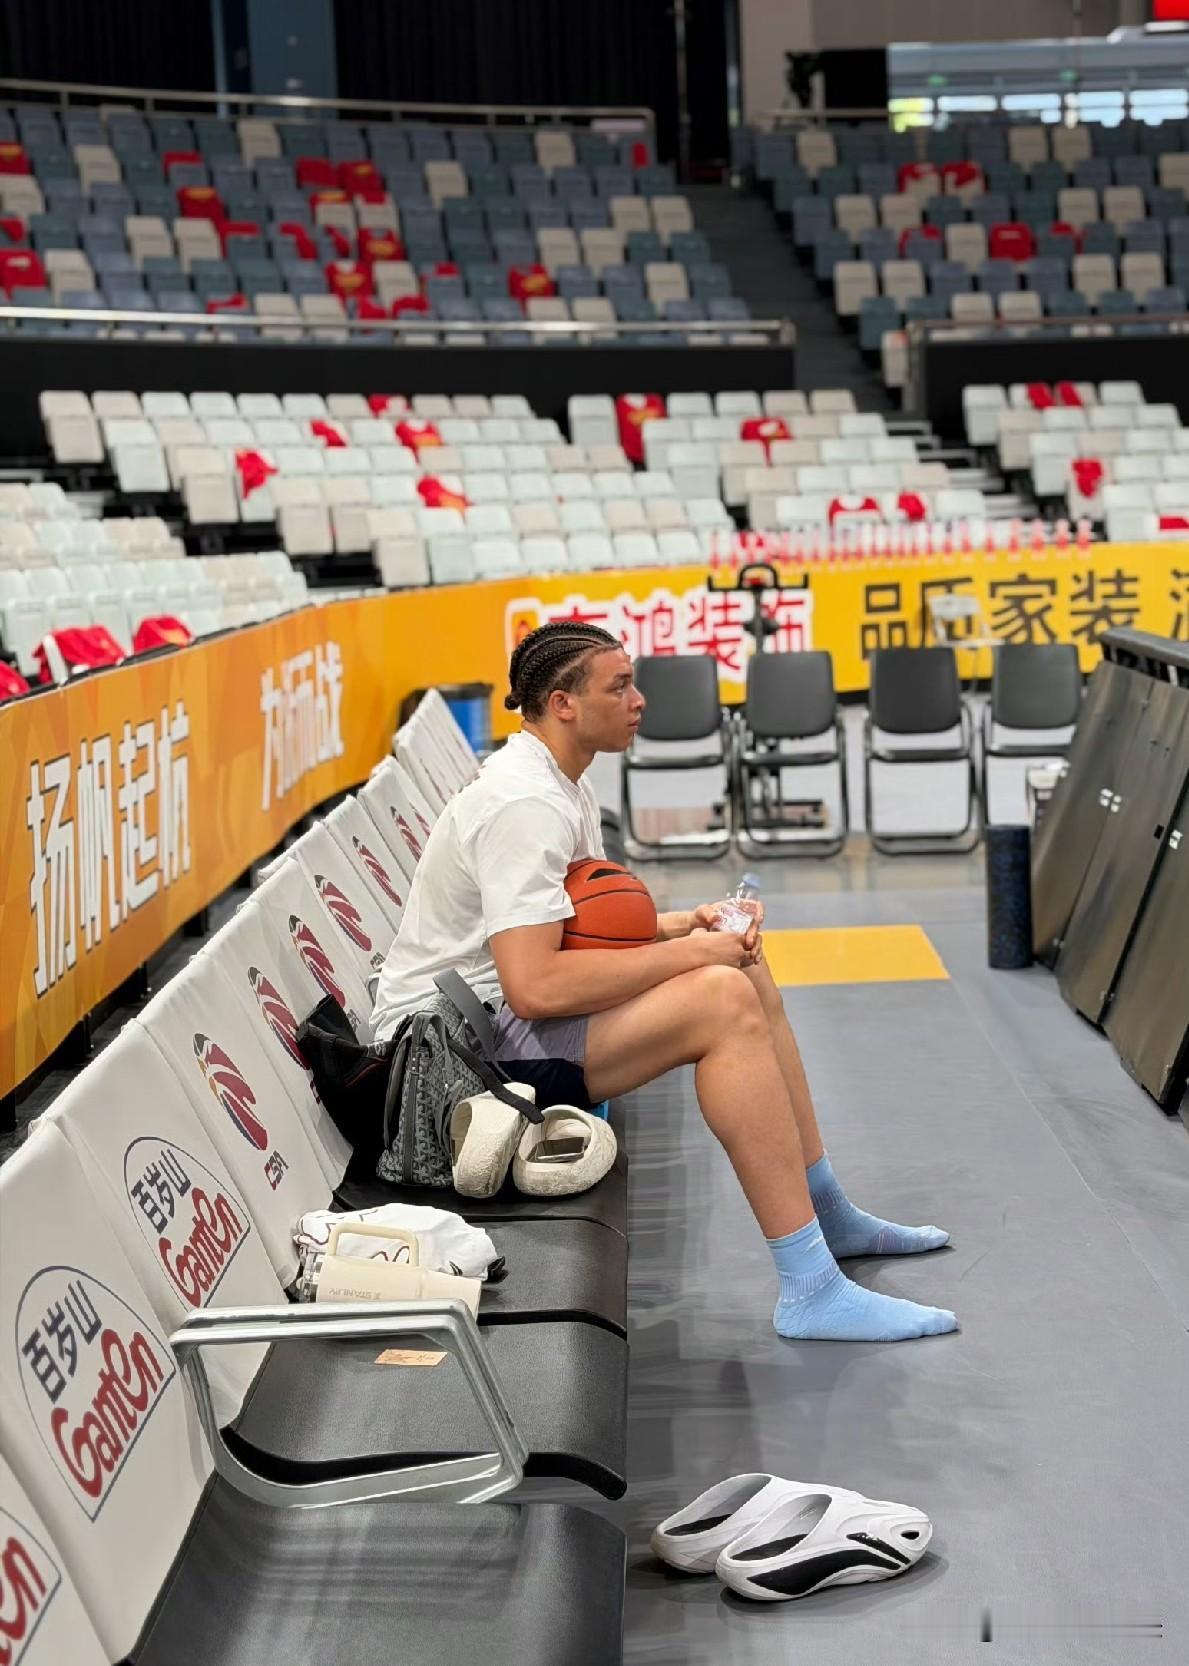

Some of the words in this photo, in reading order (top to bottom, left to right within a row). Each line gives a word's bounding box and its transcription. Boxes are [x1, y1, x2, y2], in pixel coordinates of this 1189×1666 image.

[549, 589, 804, 671] 鸿装饰
[27, 699, 191, 998] 扬帆起航
[131, 1149, 191, 1234] 百岁山
[22, 1280, 101, 1403] 百岁山
